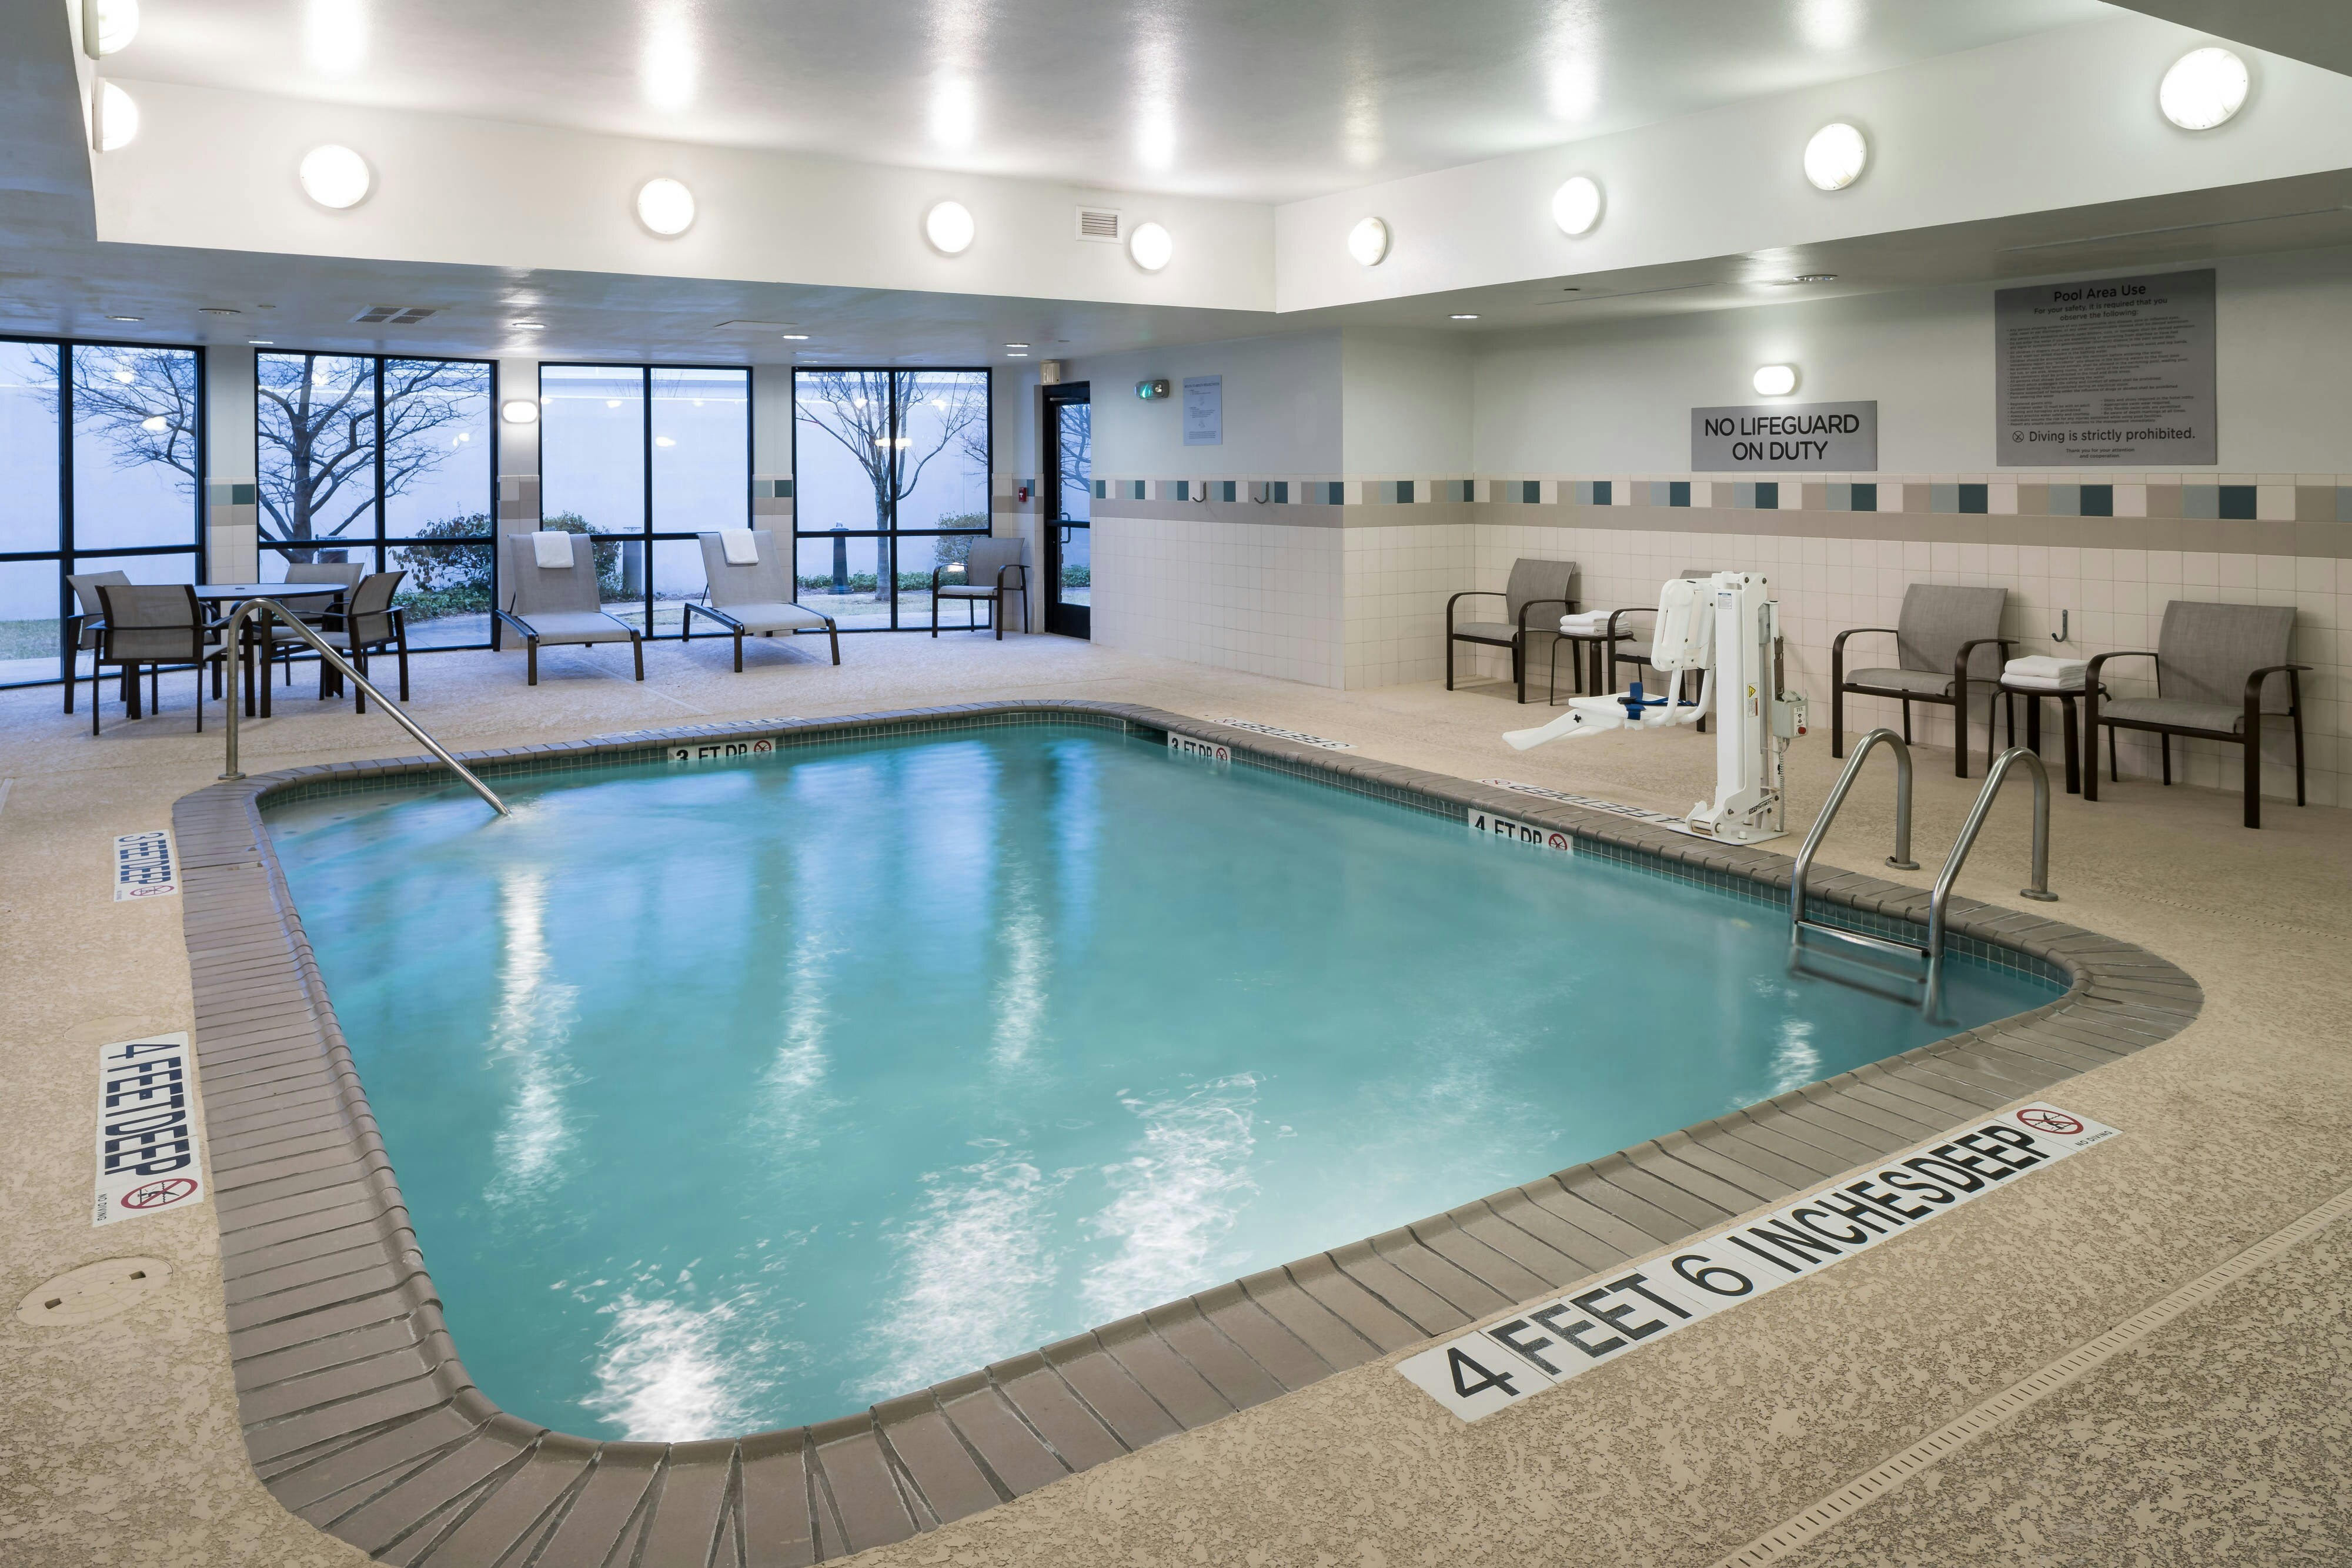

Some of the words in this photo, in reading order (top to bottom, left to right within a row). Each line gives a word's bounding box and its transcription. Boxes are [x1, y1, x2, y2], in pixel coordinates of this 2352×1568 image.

[2054, 289, 2082, 302] Pool
[2087, 286, 2117, 299] Area
[2122, 283, 2146, 296] Use
[2047, 306, 2063, 316] your
[2064, 303, 2087, 313] safety,
[2104, 299, 2134, 310] required
[2136, 297, 2152, 305] that
[2154, 297, 2167, 306] you
[2060, 313, 2088, 321] observe
[2090, 311, 2101, 319] the
[2103, 309, 2139, 318] following:
[1705, 418, 1735, 436] NO
[1741, 414, 1860, 436] LIFEGUARD
[2029, 430, 2065, 443] Diving
[2069, 430, 2078, 441] is
[2082, 429, 2122, 443] strictly
[2126, 427, 2196, 442] prohibited.
[1732, 442, 1763, 460] ON
[1770, 441, 1828, 460] DUTY
[699, 745, 721, 759] FT
[726, 744, 747, 757] DP
[1184, 740, 1197, 754] FT
[1199, 744, 1212, 757] DP
[118, 832, 164, 842] 3
[1475, 815, 1485, 831] 4
[1495, 820, 1516, 838] FT
[1521, 826, 1542, 844] DP
[108, 1044, 181, 1059] 4
[2087, 1131, 2113, 1142] DIVING
[98, 1193, 108, 1202] NO
[97, 1202, 108, 1221] DIVING
[1446, 1346, 1521, 1399] 4
[1487, 1272, 1694, 1376] FEET
[1671, 1254, 1754, 1297] 6
